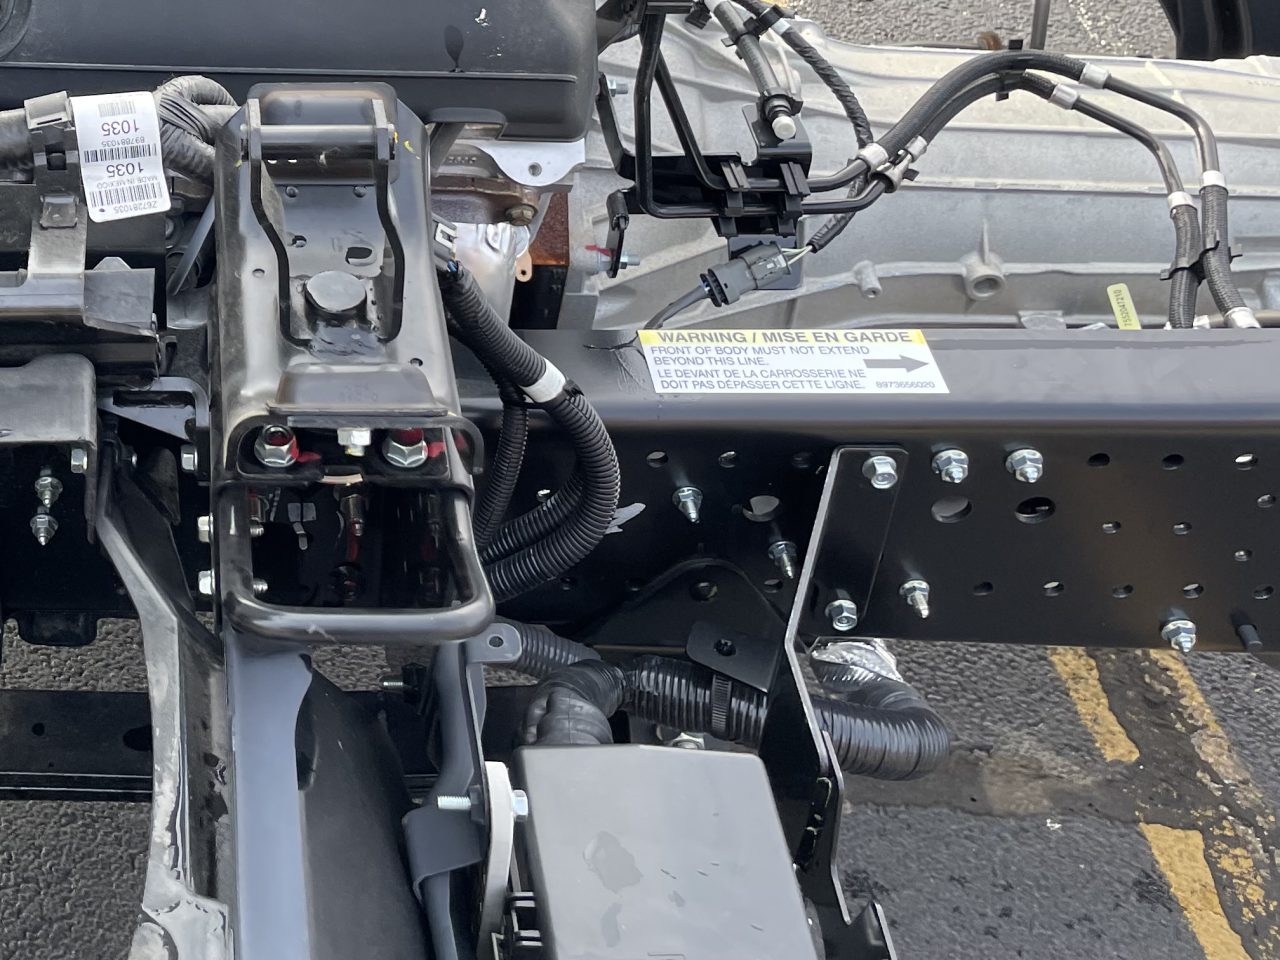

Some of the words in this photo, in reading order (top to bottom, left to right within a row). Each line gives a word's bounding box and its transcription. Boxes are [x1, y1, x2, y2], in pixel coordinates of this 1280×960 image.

[101, 119, 140, 136] 1035
[106, 162, 144, 178] 1035
[136, 175, 158, 184] MADE
[97, 180, 126, 189] MEXICO
[657, 332, 747, 343] WARNING
[761, 332, 808, 343] MISE
[812, 332, 839, 343] EN
[843, 332, 913, 343] GARDE
[651, 346, 691, 355] FRONT
[695, 346, 713, 355] OF
[716, 346, 748, 355] BODY
[752, 346, 786, 355] MUST
[790, 346, 815, 355] NOT
[819, 346, 870, 355] EXTEND
[654, 357, 704, 366] BEYOND
[706, 357, 735, 366] THIS
[738, 357, 770, 366] LINE.
[657, 369, 672, 378] LE
[675, 369, 720, 378] DEVANT
[723, 369, 741, 378] DE
[742, 369, 758, 378] LA
[760, 369, 846, 378] CARROSSERIE
[848, 369, 867, 378] NE
[660, 380, 690, 389] DOIT
[692, 380, 715, 389] PAS
[782, 380, 823, 389] CETTE
